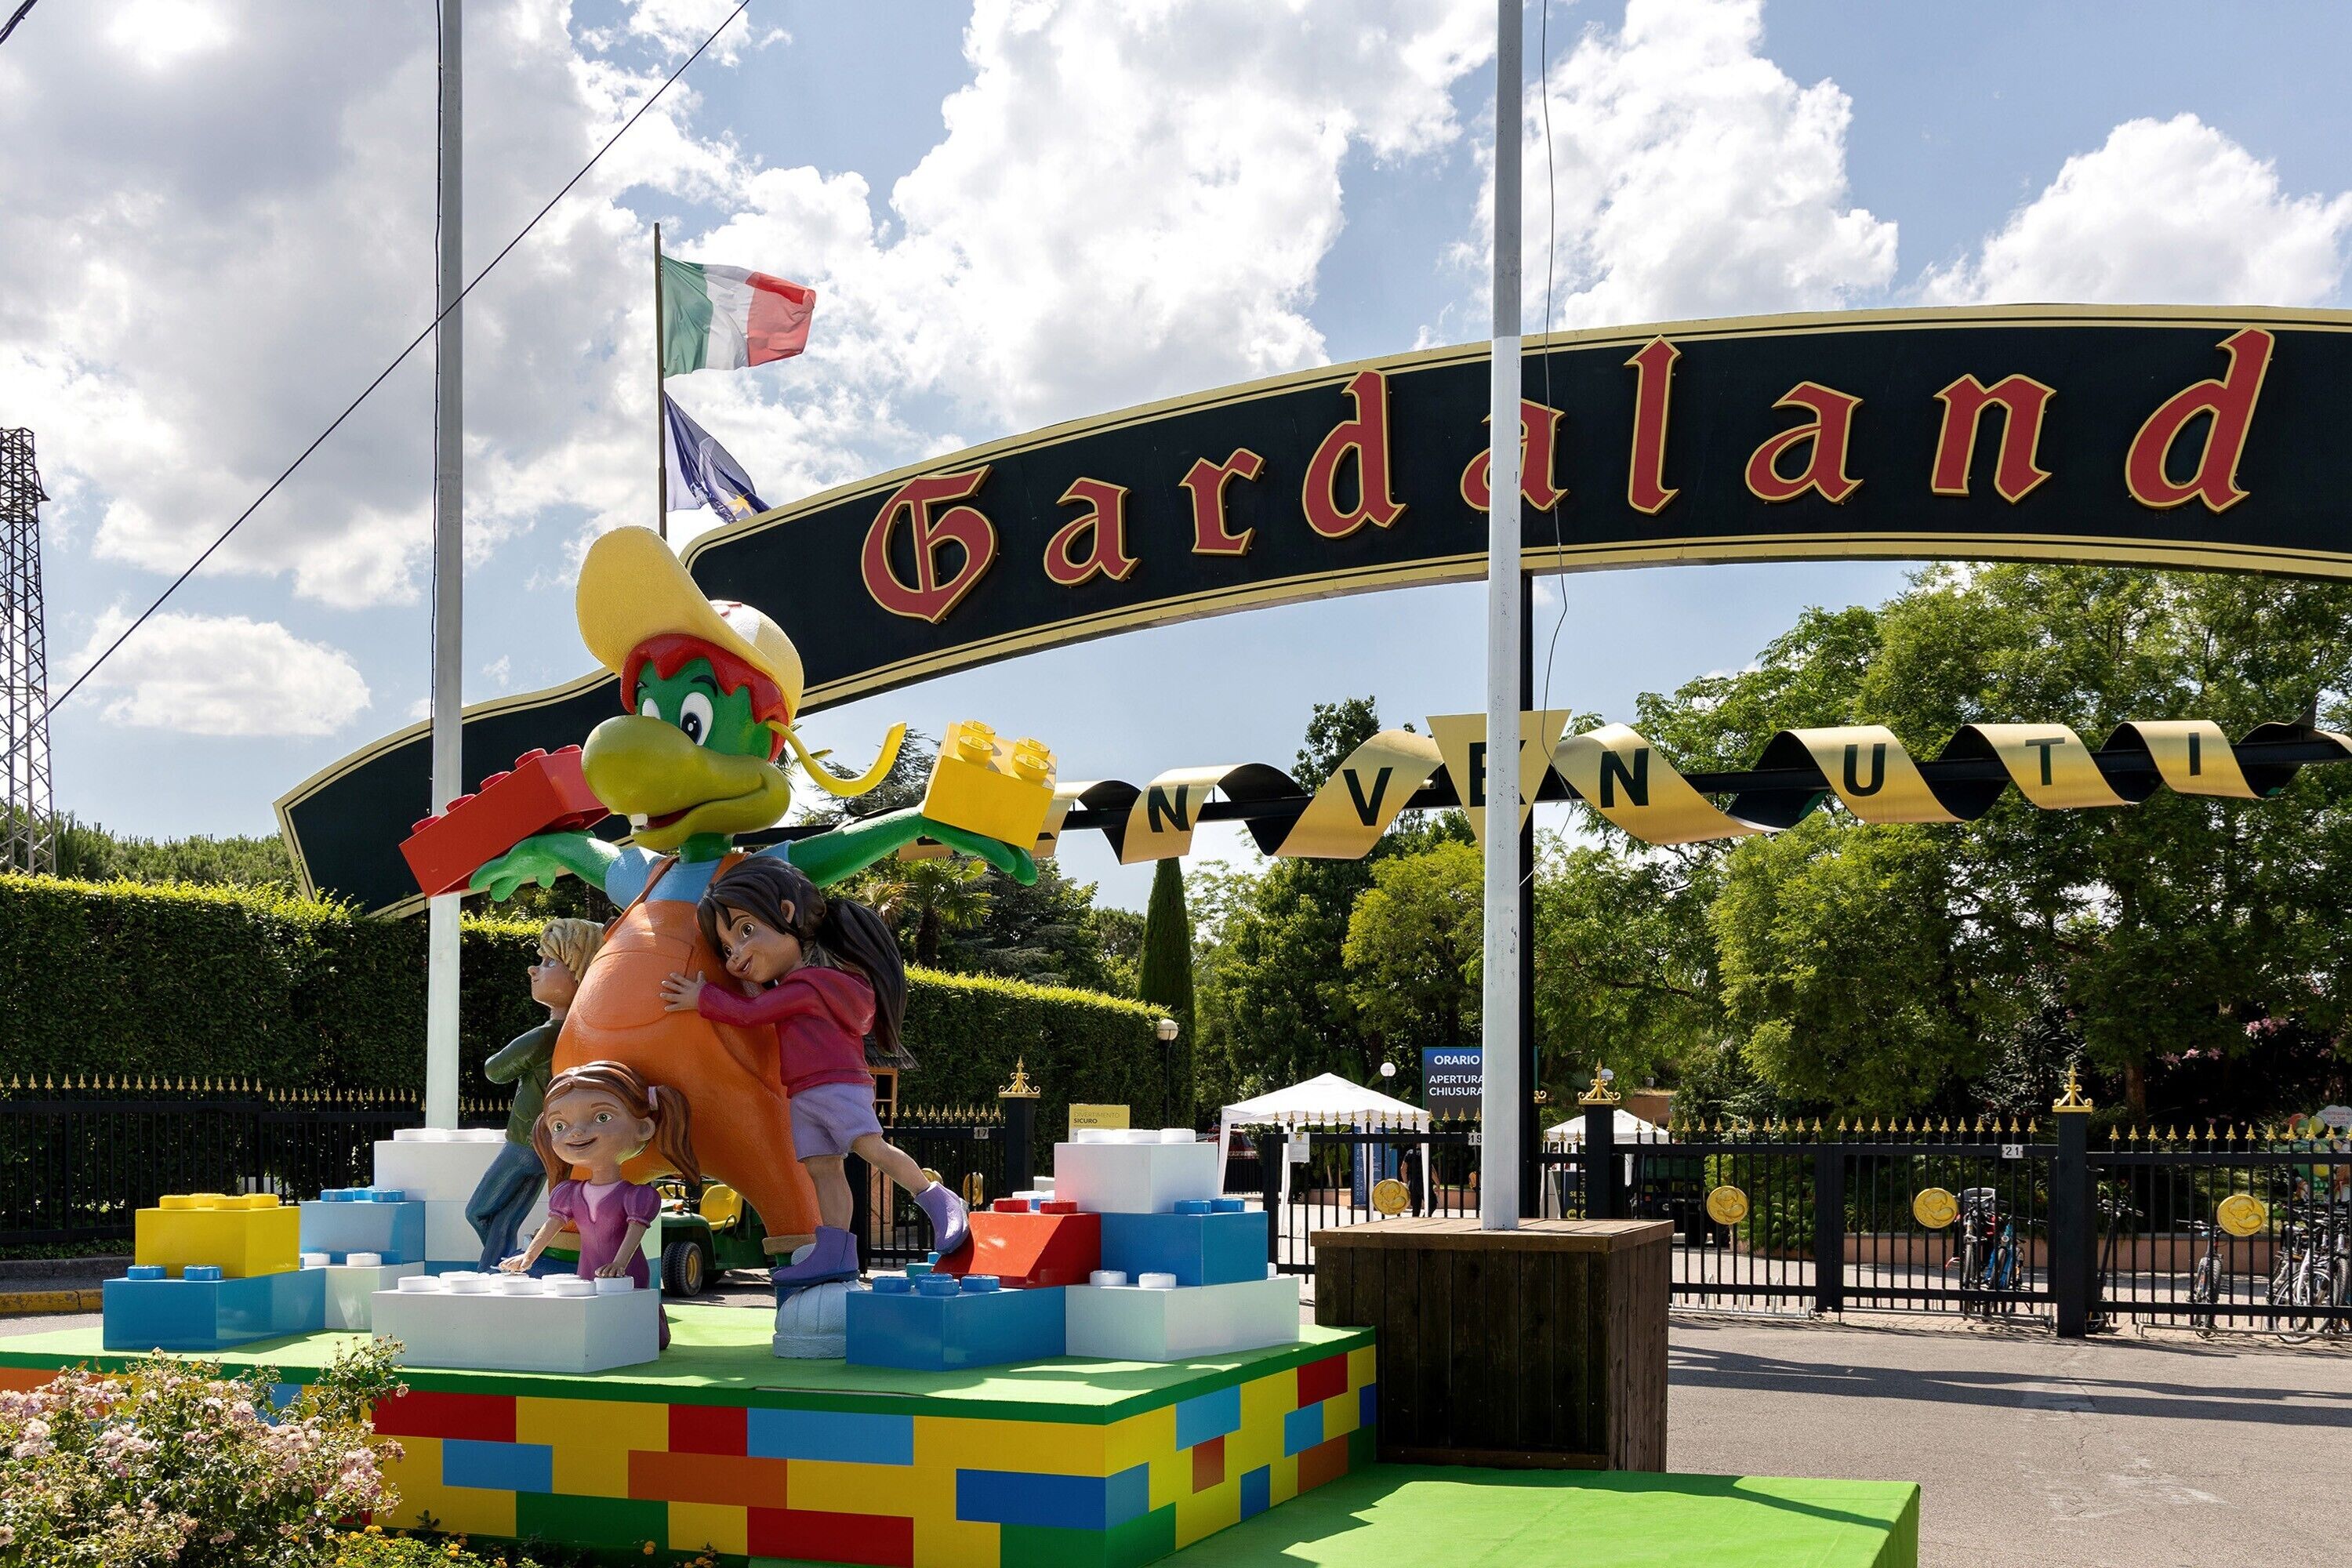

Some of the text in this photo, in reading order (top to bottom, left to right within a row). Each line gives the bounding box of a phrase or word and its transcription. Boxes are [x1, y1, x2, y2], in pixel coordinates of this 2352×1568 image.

[861, 325, 2275, 624] Gardaland
[916, 732, 2201, 846] NVNUTI
[1434, 1055, 1480, 1065] ORARIO
[1428, 1075, 1483, 1083] APERTURA
[1428, 1087, 1483, 1096] CHIUSURA
[1470, 1134, 1482, 1143] 19
[2005, 1145, 2020, 1156] 21
